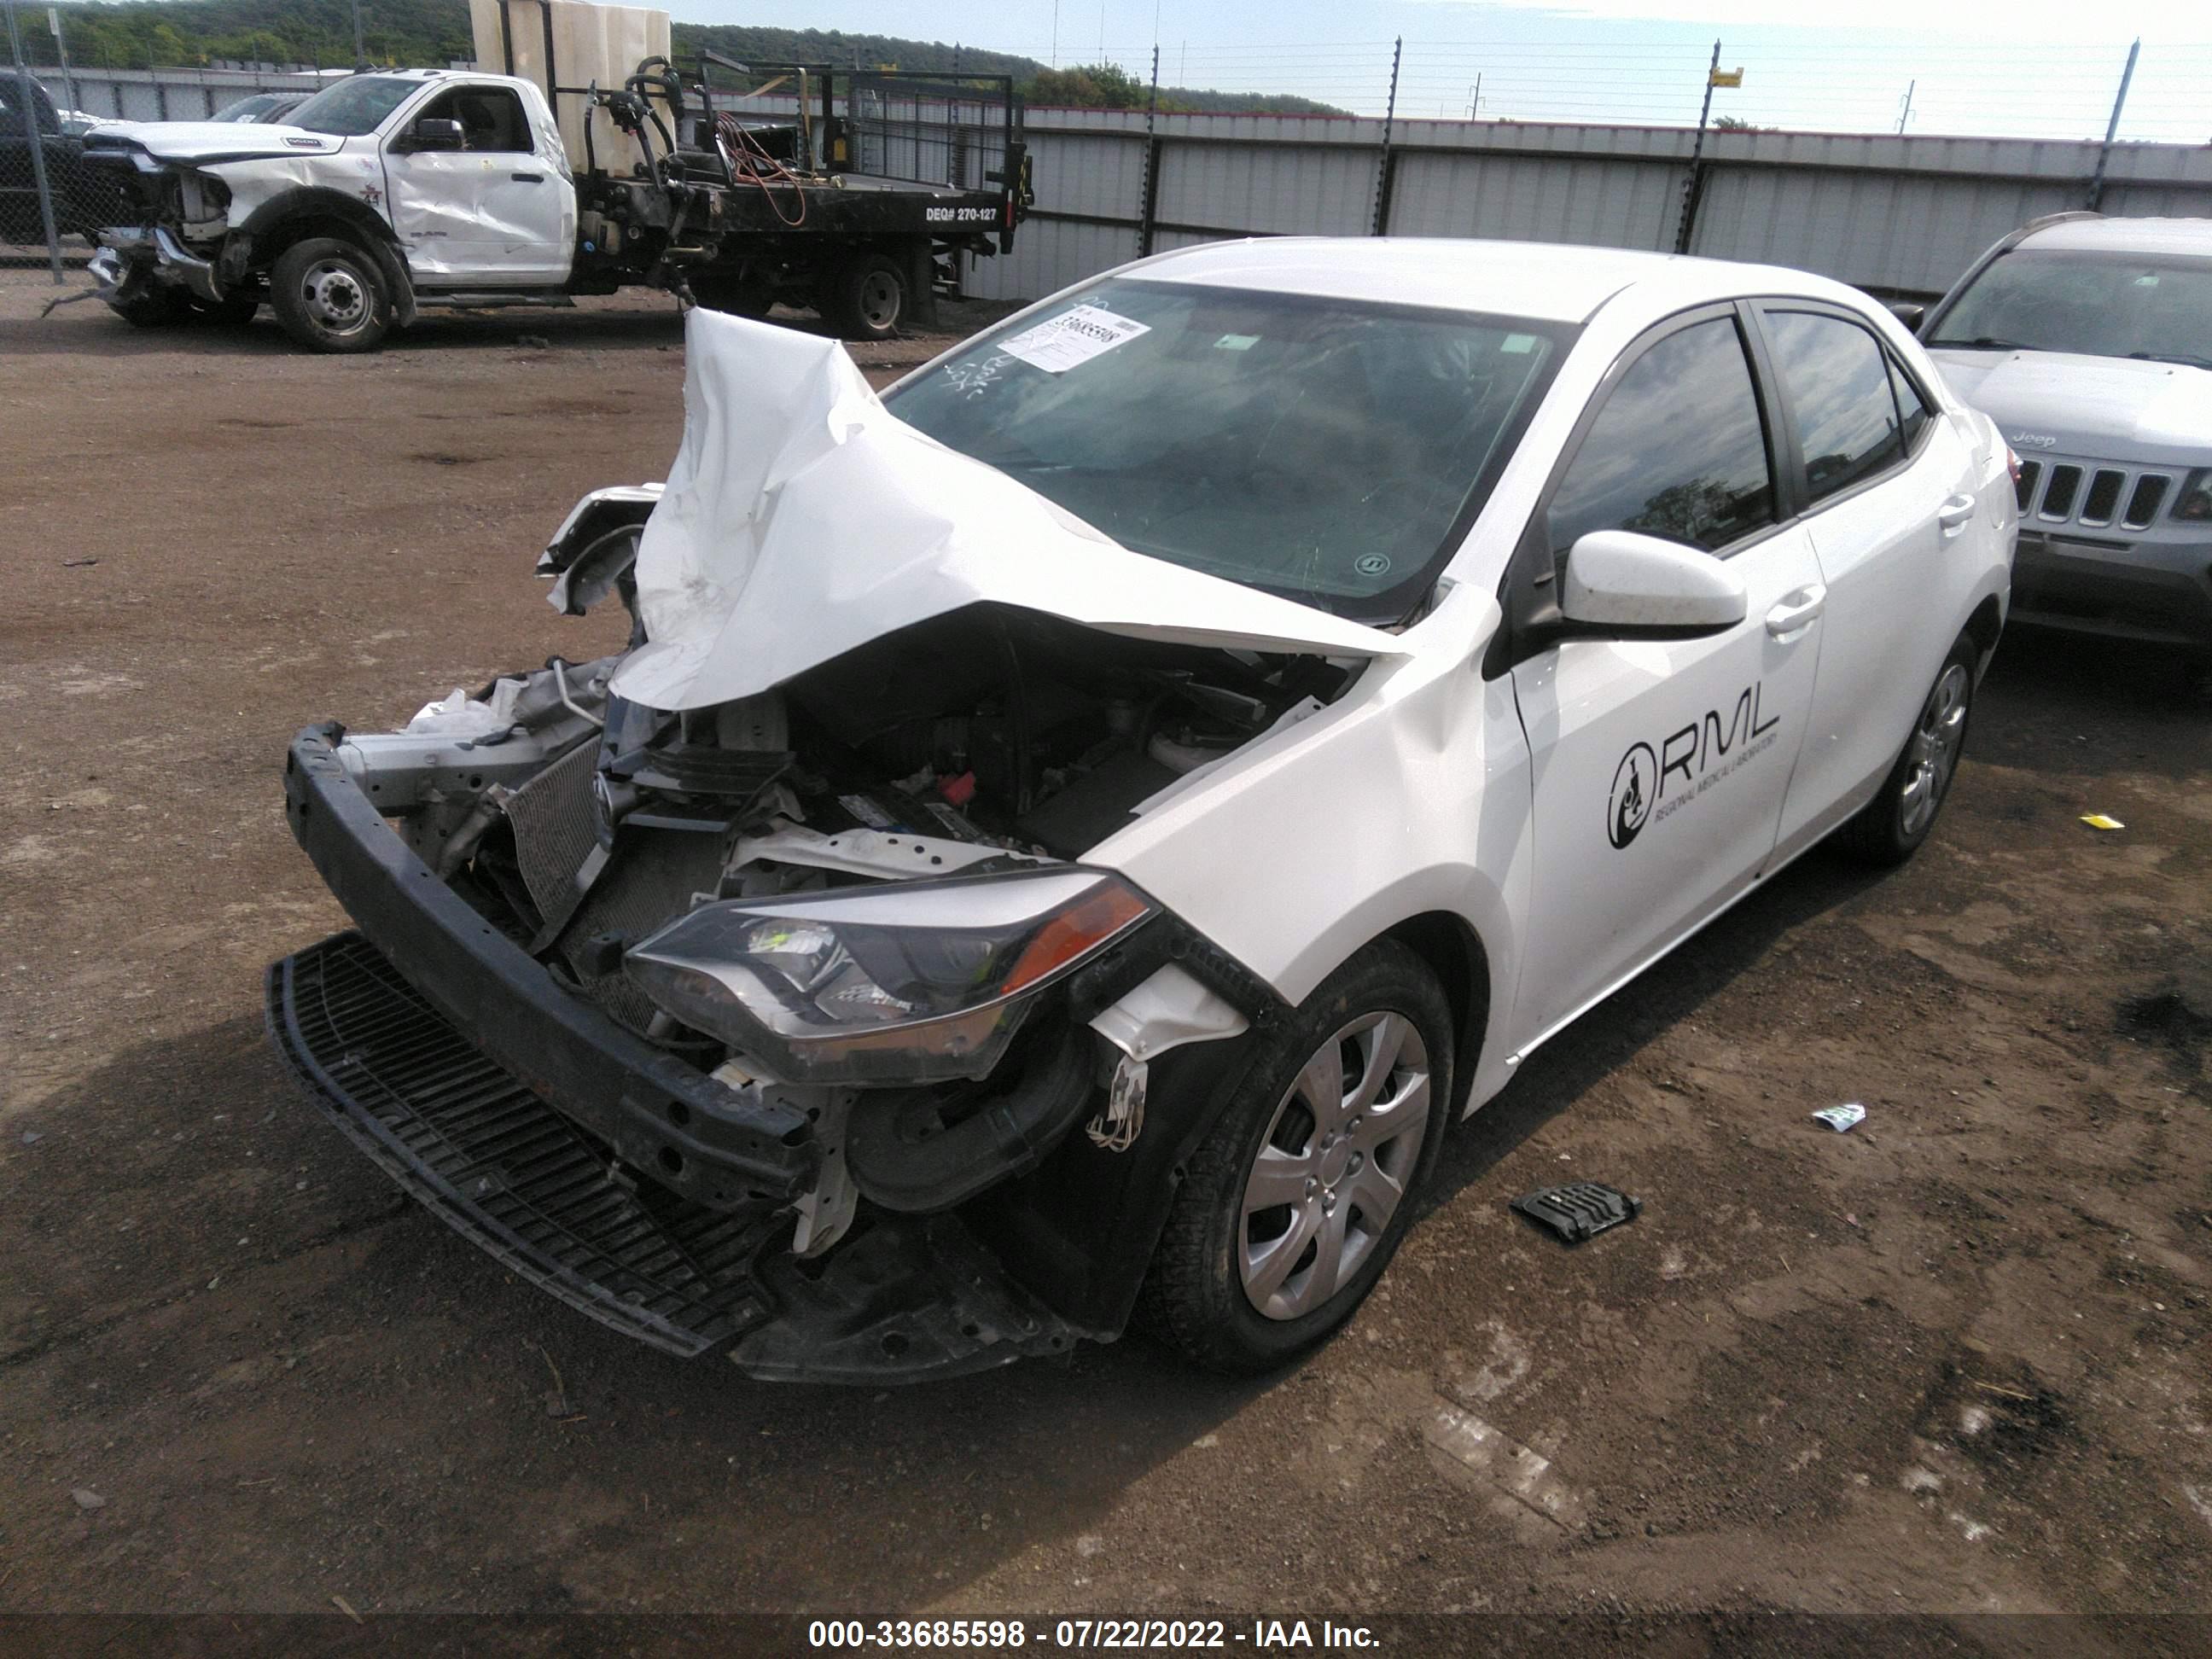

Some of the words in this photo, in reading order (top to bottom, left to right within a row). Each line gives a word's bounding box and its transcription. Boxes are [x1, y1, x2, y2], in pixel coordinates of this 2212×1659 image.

[925, 207, 955, 221] DEQ#
[958, 207, 997, 221] 270-127
[2012, 432, 2056, 448] Jeep
